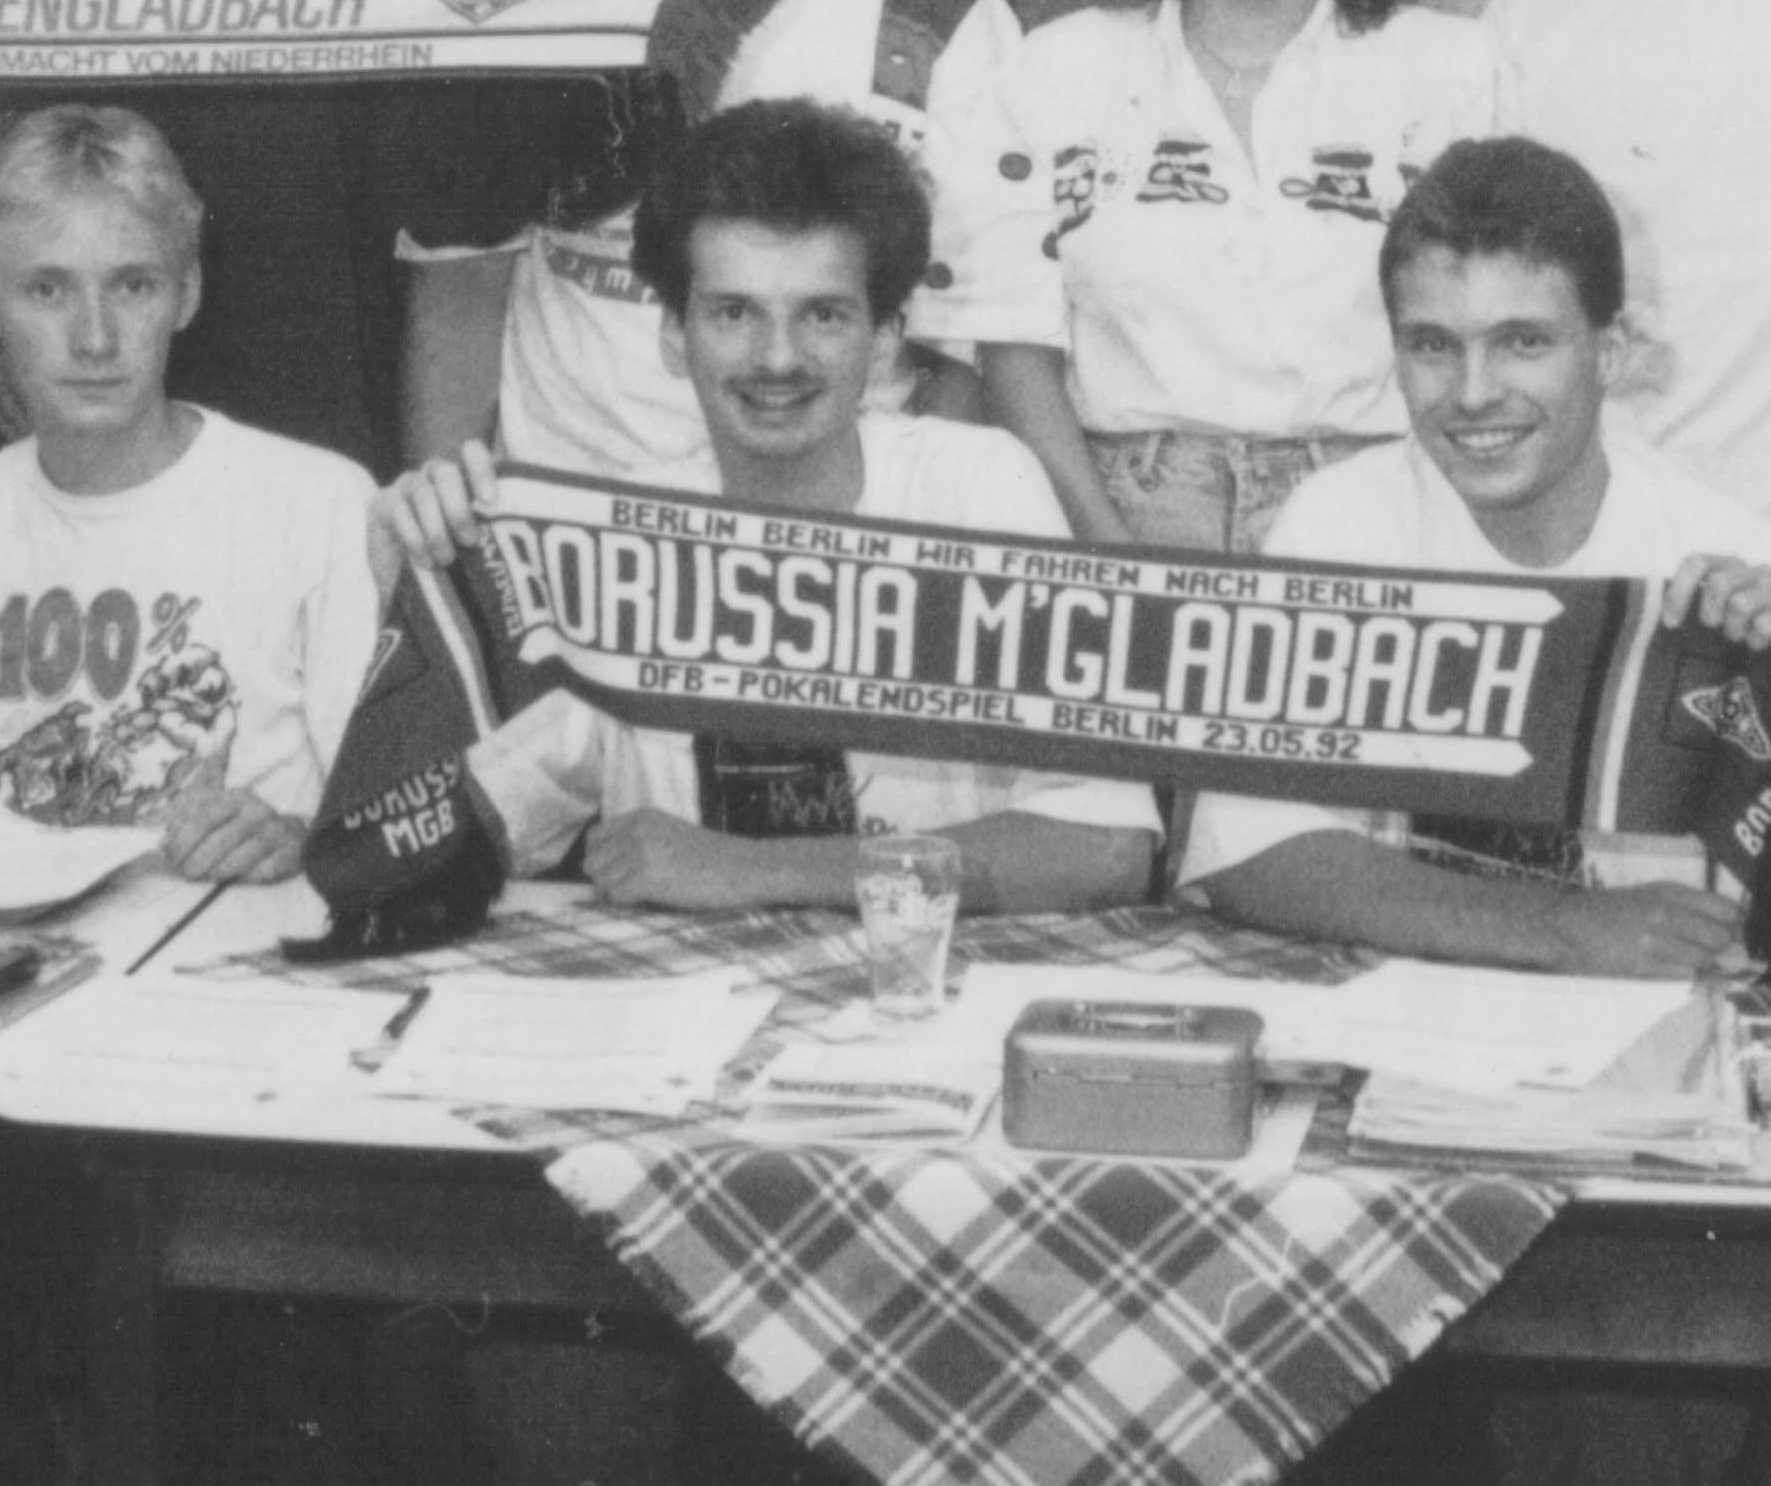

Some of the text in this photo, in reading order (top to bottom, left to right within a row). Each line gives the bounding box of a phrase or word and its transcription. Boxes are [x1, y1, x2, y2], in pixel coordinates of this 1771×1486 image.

[0, 47, 112, 74] MACHT
[126, 48, 200, 74] VOM
[210, 43, 433, 72] NIEDERRHEIN
[612, 498, 1413, 609] BERLIN BERLIN WIR FAHREN NACH BERLIN
[491, 519, 918, 680] BORUSSIA
[1051, 705, 1177, 742] BERLIN
[1202, 721, 1362, 760] 23.05.92
[381, 798, 455, 857] MGB
